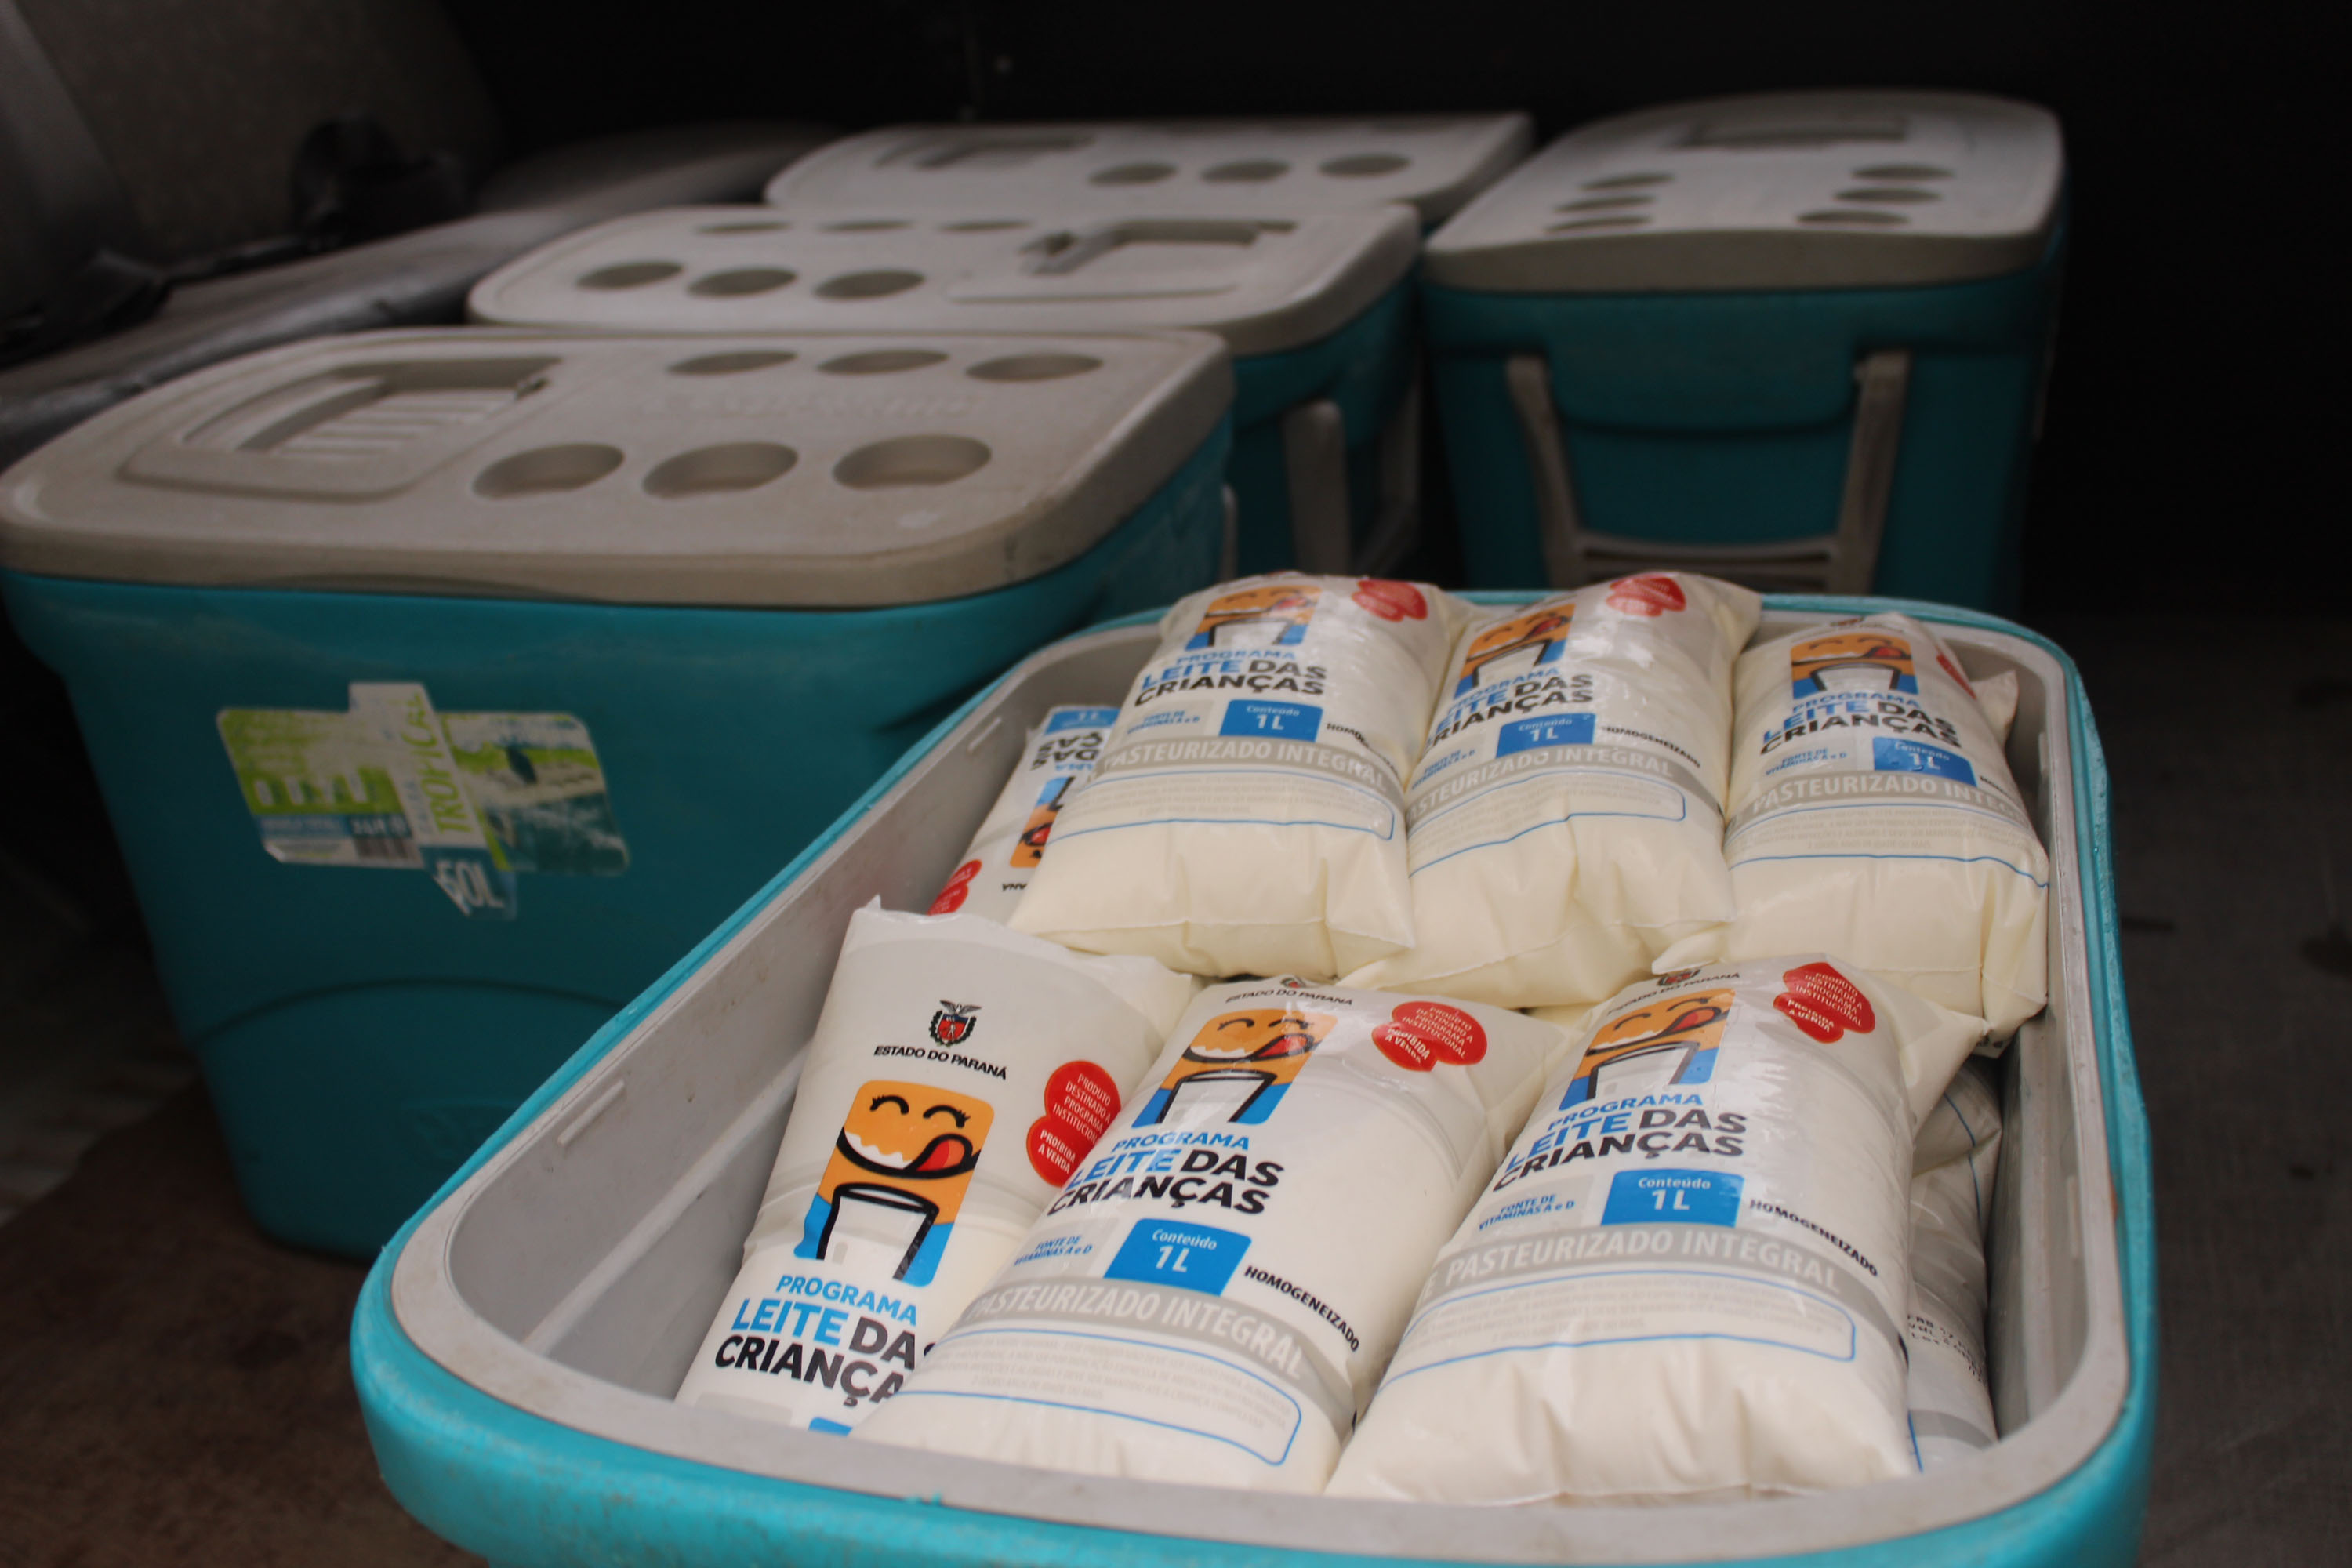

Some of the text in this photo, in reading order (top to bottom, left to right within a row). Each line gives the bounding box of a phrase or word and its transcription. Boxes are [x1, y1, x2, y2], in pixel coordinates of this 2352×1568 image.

[1142, 659, 1327, 690] LEITE DAS
[1177, 649, 1296, 665] PROGRAMA
[1134, 675, 1326, 706] CRIANÇAS
[1427, 674, 1594, 746] EITE DAS
[1792, 691, 1920, 713] PROGRAMA
[1760, 714, 1962, 755] CRIANÇAS
[1763, 700, 1958, 742] LEITE DAS
[1276, 742, 1388, 792] INTEGRAL
[1409, 751, 1549, 820] ASTEURIZADO
[1555, 746, 1675, 779] INTEGRAL
[1753, 772, 1937, 815] PASTEURIZADO
[1402, 1016, 1467, 1059] INSTITUCIONAL
[1414, 1014, 1465, 1047] PROGRAMA
[1415, 1008, 1467, 1036] DESTINADO
[1429, 1007, 1472, 1032] PRODUTO
[873, 1045, 1007, 1080] ESTADO DO PARANÁ
[1385, 1034, 1423, 1064] A VENDA
[1065, 1080, 1111, 1123] DESTINADO A
[1077, 1073, 1111, 1106] PRODUTO
[1052, 1103, 1098, 1145] INSTITUCION
[1063, 1095, 1104, 1134] PROGRAMA
[1548, 1094, 1704, 1132] PROGRAMA
[1038, 1142, 1071, 1174] A VENDA
[1040, 1129, 1076, 1164] PROIBIDA
[1112, 1131, 1250, 1153] PROGRAMA
[1492, 1131, 1745, 1192] CRIANÇAS
[1504, 1109, 1748, 1174] LEITE DAS
[1064, 1149, 1286, 1192] LEITE DAS
[1638, 1177, 1711, 1190] Conteúdo
[1047, 1176, 1271, 1216] CRIANÇAS
[1478, 1204, 1544, 1231] VITAMINAS
[1563, 1200, 1575, 1210] D
[1500, 1194, 1557, 1214] FONTE DE
[1152, 1229, 1218, 1251] Conteúdo
[1749, 1198, 1878, 1277] HOMOGENEIZADO
[1444, 1228, 1675, 1287] PASTEURIZADO
[1683, 1229, 1841, 1294] INTEGRAL
[775, 1274, 917, 1327] PROGRAMA
[1243, 1265, 1361, 1354] HOMOGENEIZADO
[731, 1298, 936, 1371] LEITE DA
[966, 1283, 1305, 1381] PASTEURIZADO INTEGRAL
[714, 1334, 905, 1408] CRIANÇA
